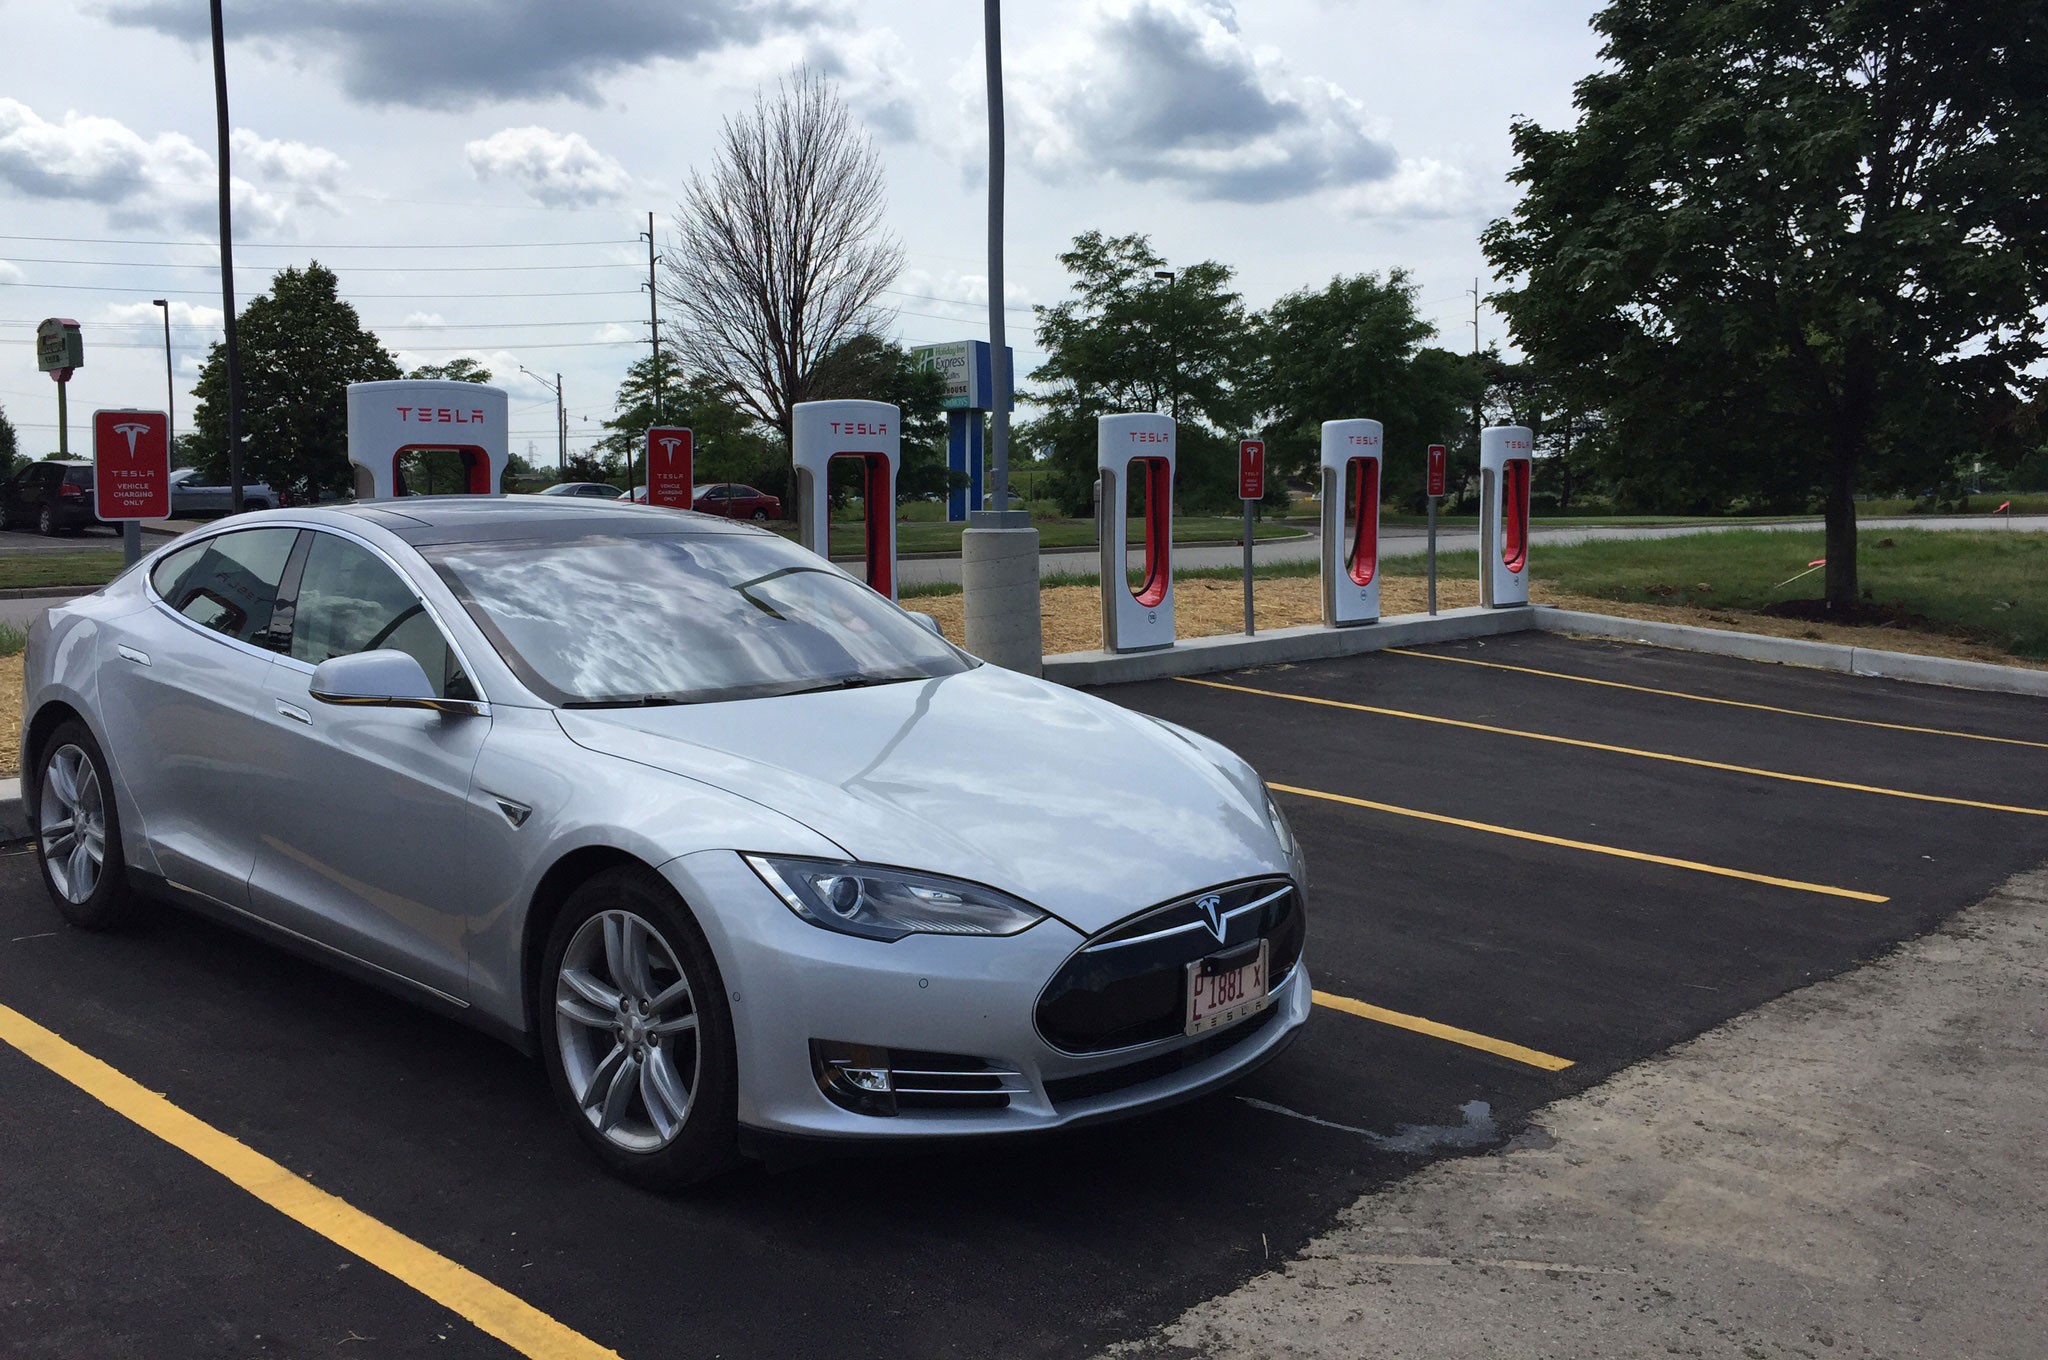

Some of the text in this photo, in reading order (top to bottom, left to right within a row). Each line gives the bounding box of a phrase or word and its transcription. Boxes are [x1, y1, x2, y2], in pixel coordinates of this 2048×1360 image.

[935, 356, 965, 370] Express
[396, 407, 483, 424] TESLA
[830, 422, 887, 435] TESLA
[1129, 432, 1169, 443] TESLA
[1348, 436, 1378, 446] TESLA
[1505, 440, 1531, 449] TESLA
[111, 470, 155, 478] TESLA
[117, 482, 149, 490] VEHICLE
[1208, 967, 1244, 1009] 1881
[1253, 966, 1261, 988] X
[1194, 1001, 1262, 1032] TESLA
